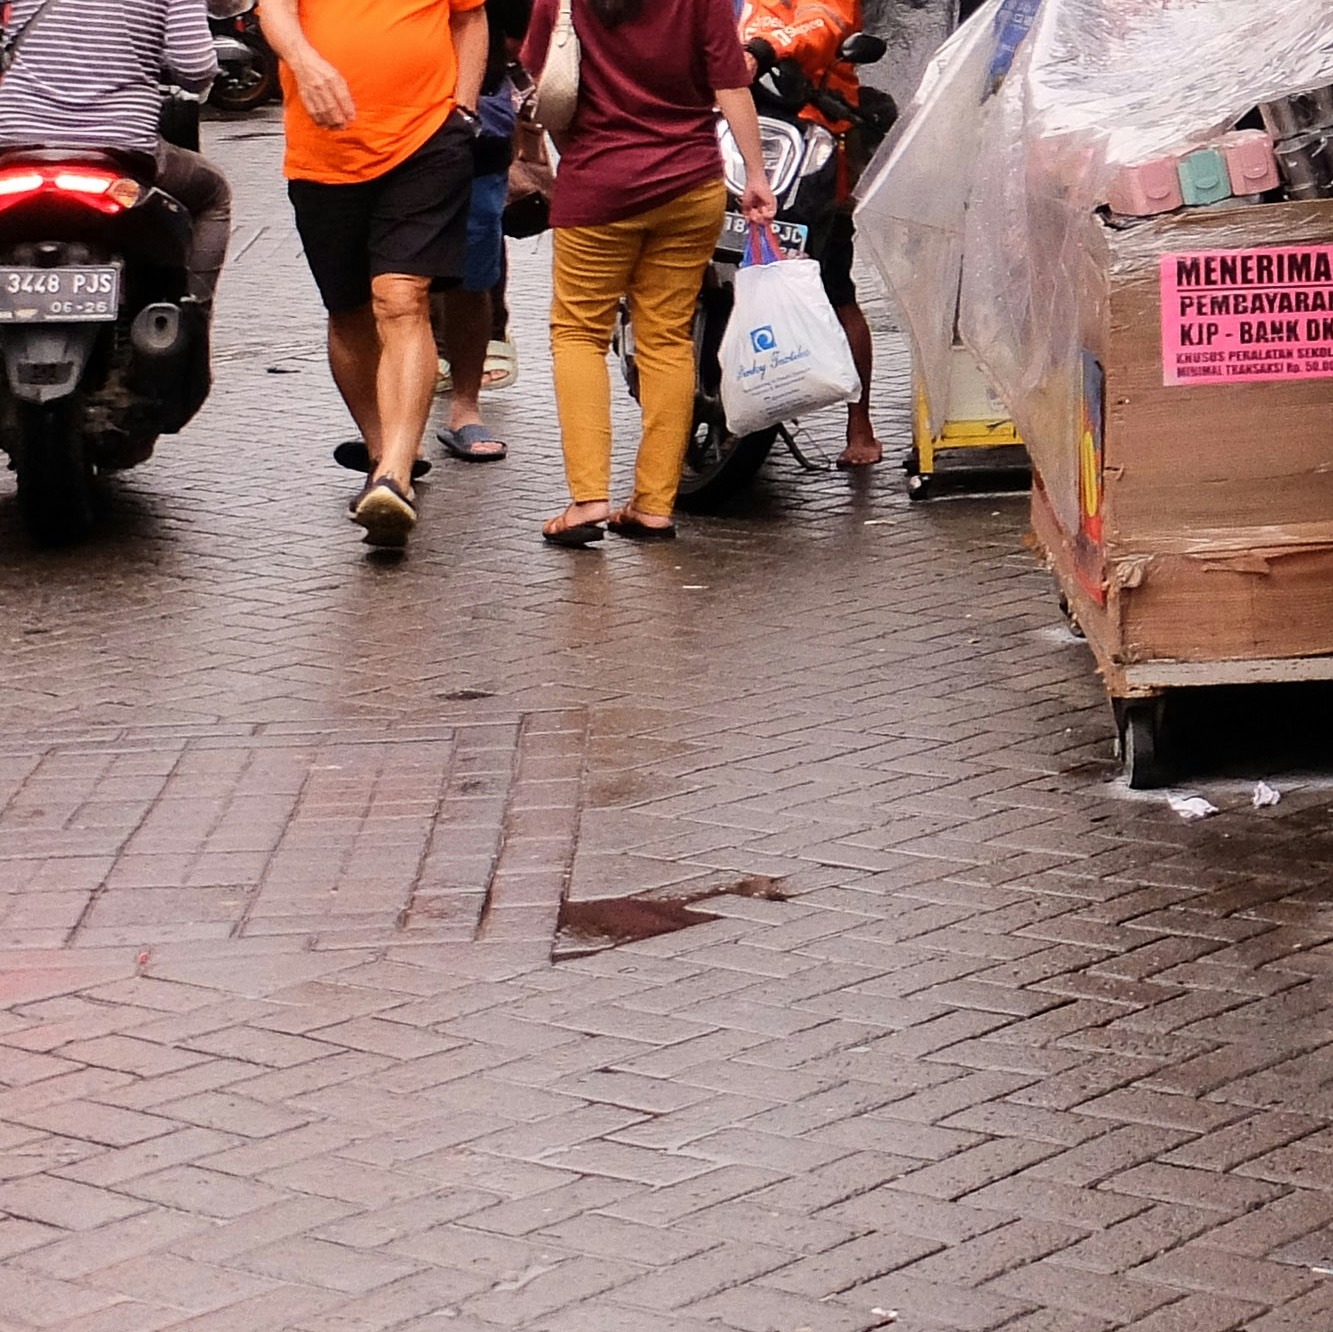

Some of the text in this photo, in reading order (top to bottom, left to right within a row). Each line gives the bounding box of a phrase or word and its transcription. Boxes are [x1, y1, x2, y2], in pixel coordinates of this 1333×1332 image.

[1176, 252, 1332, 287] MENERIMA
[8, 274, 112, 293] 3448 PJS
[1180, 322, 1219, 346] KJP
[1240, 320, 1300, 344] BANK
[1228, 347, 1294, 361] PERALATAN
[1225, 363, 1284, 377] TRANSAKSI
